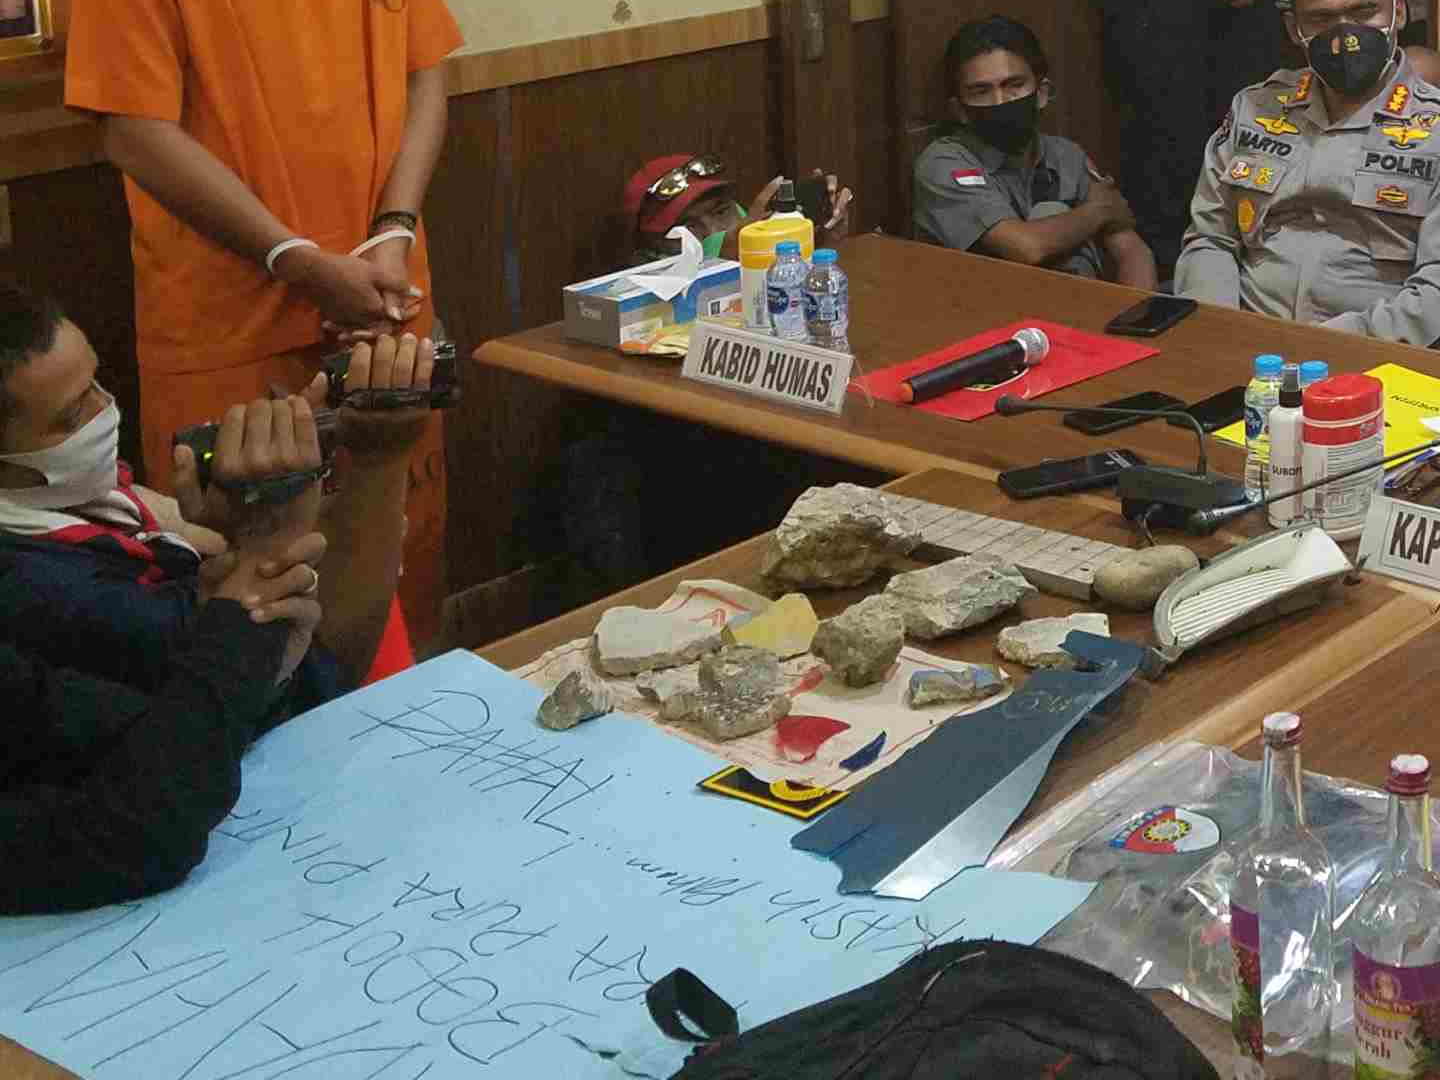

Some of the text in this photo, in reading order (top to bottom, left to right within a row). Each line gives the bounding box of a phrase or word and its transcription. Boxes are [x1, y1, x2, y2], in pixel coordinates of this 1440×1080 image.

[1364, 151, 1432, 179] POLRI
[700, 336, 833, 402] KABID HUMAS
